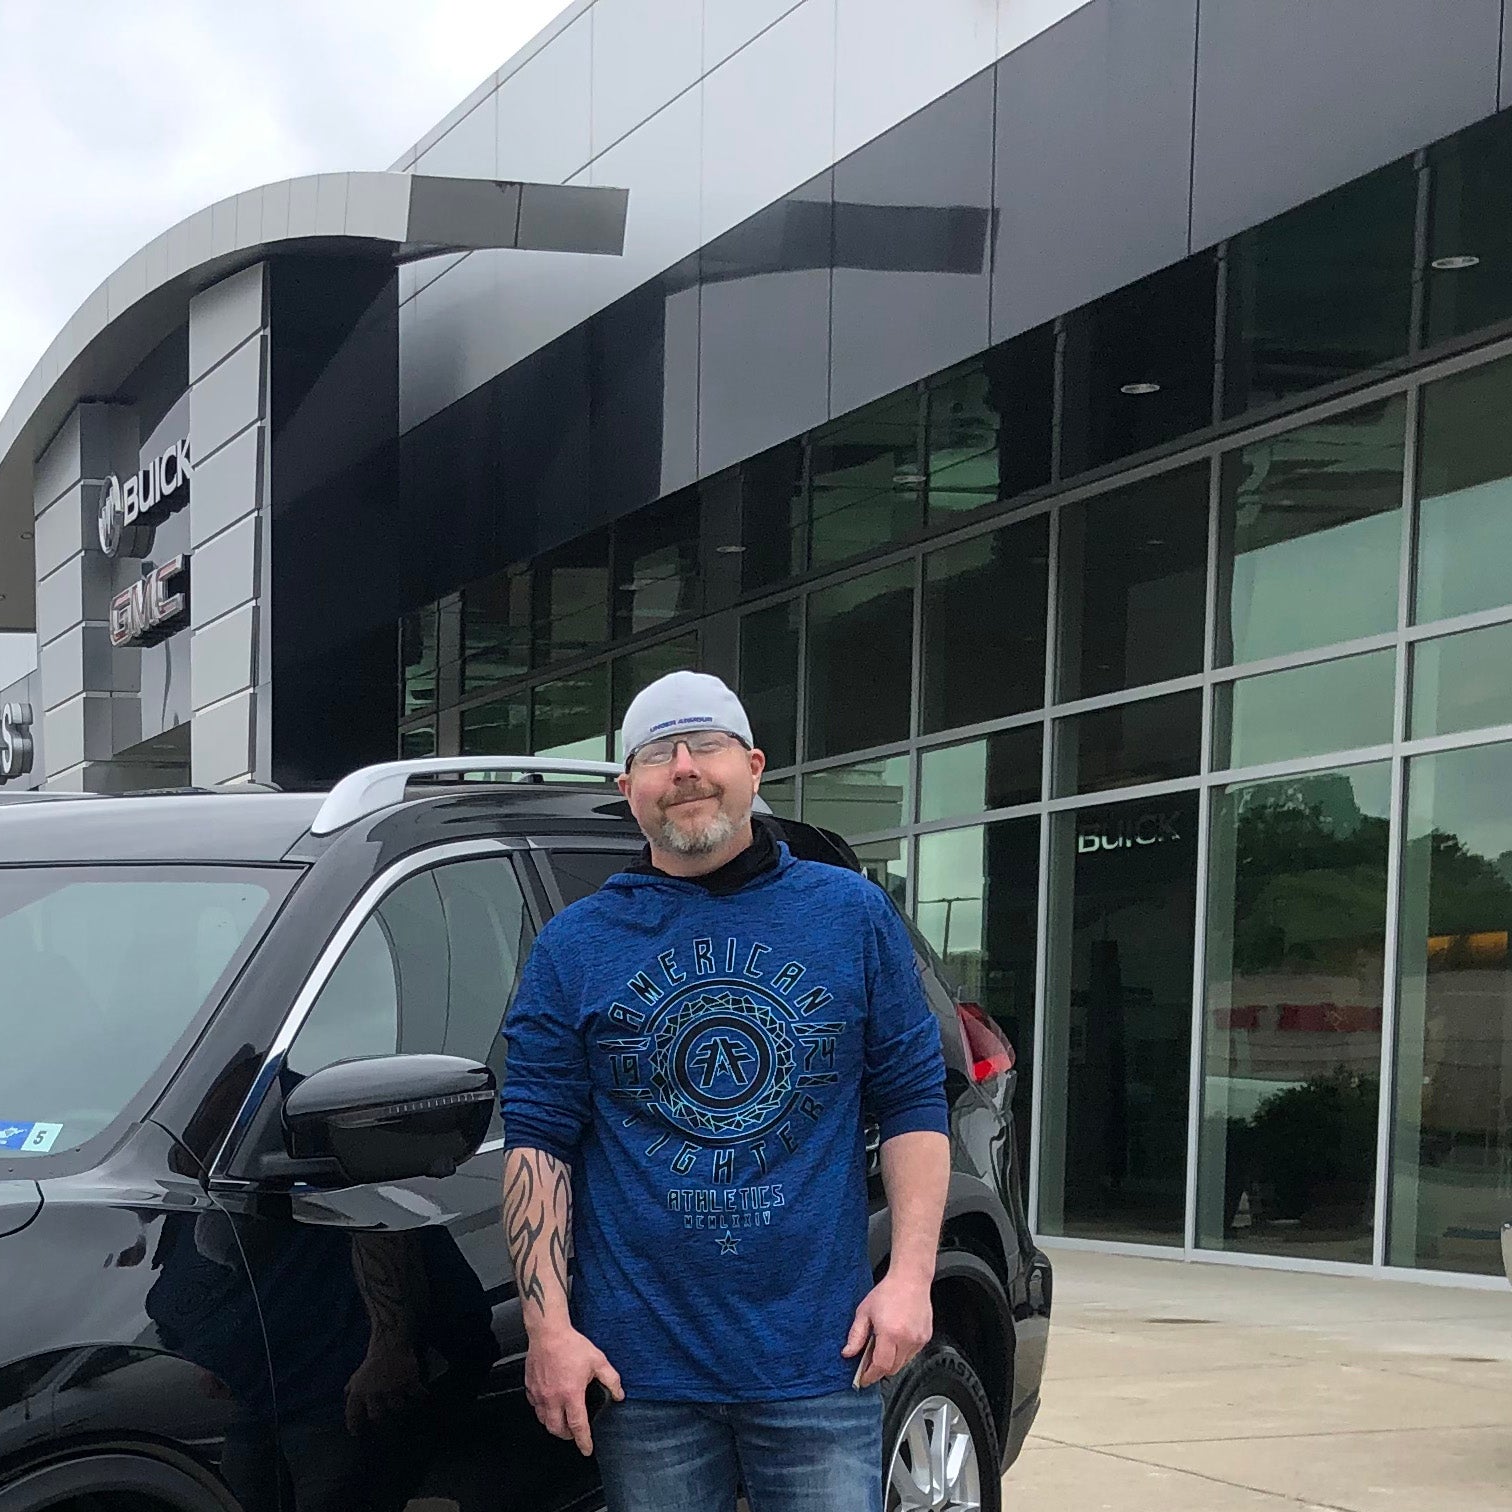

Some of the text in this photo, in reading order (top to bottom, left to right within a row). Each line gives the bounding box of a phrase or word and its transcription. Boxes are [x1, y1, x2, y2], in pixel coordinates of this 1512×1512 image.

[123, 434, 191, 527] BUICK
[109, 554, 185, 646] GMC
[608, 937, 834, 1033] AMERICAN
[609, 1037, 836, 1086] 19 74
[33, 1131, 48, 1145] 5
[623, 1095, 825, 1185] FIGHTER
[668, 1184, 785, 1212] ATHLETICS
